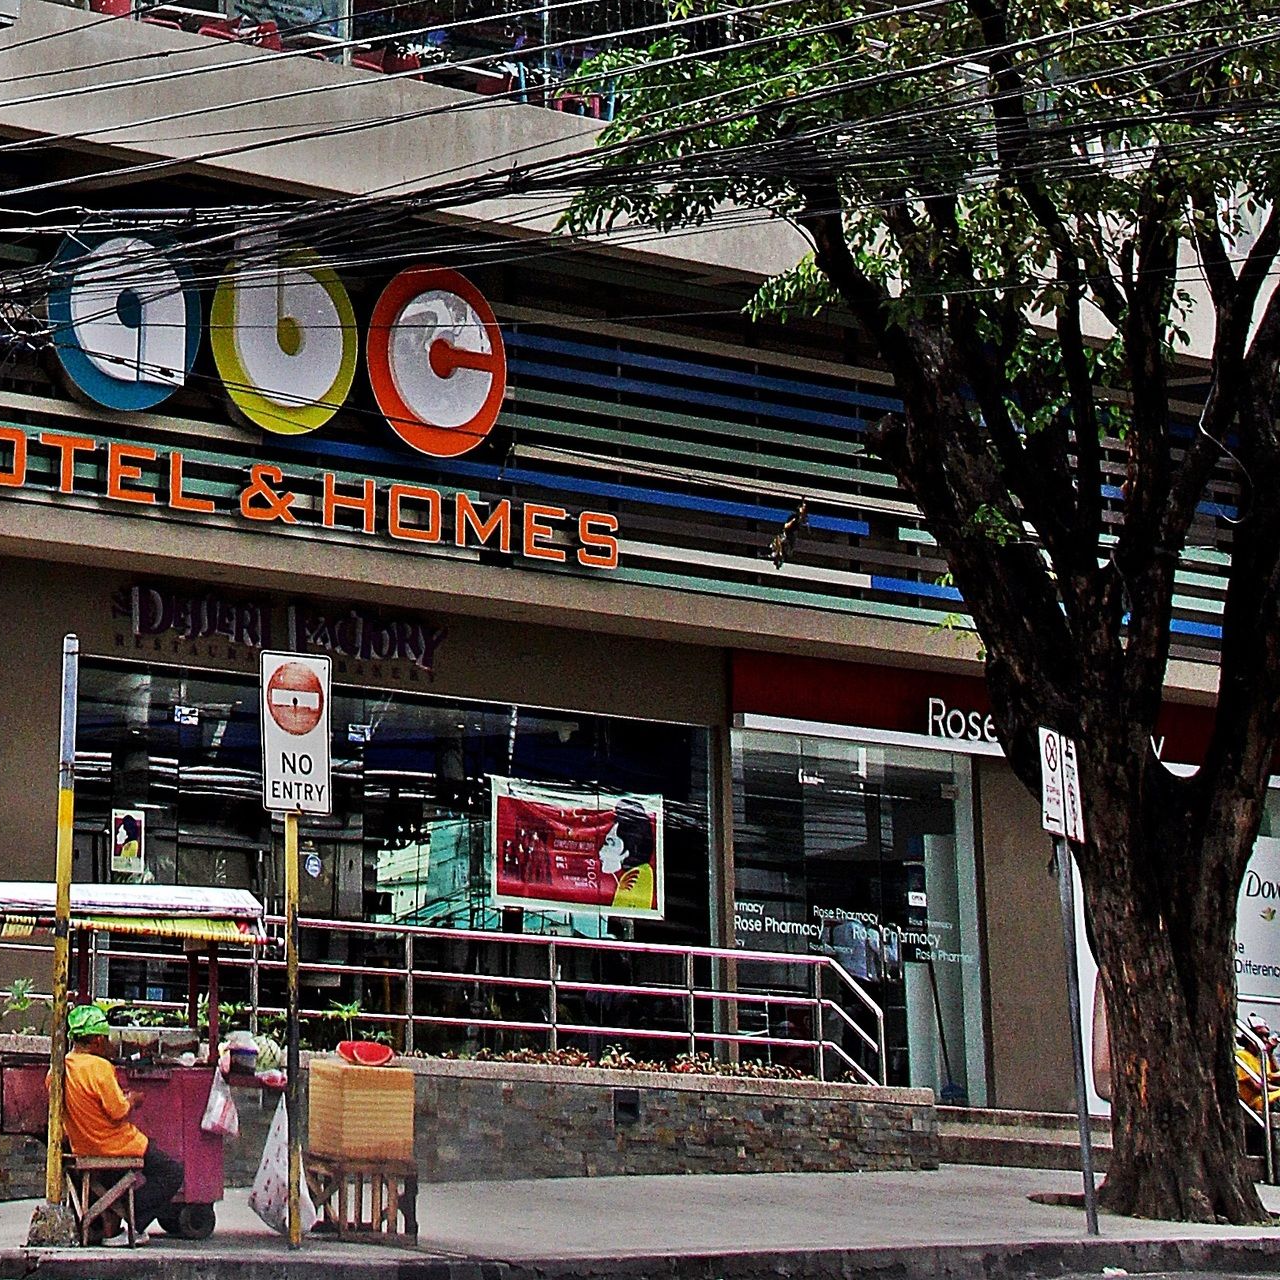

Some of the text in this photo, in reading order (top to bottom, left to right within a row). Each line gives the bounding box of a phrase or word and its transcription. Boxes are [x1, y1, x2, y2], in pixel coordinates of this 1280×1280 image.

[240, 464, 298, 525] &
[320, 472, 619, 570] HOMES
[928, 696, 999, 743] Rose
[281, 752, 314, 776] NO
[271, 781, 326, 802] ENTRY
[734, 915, 823, 940] Rose Pharmacy
